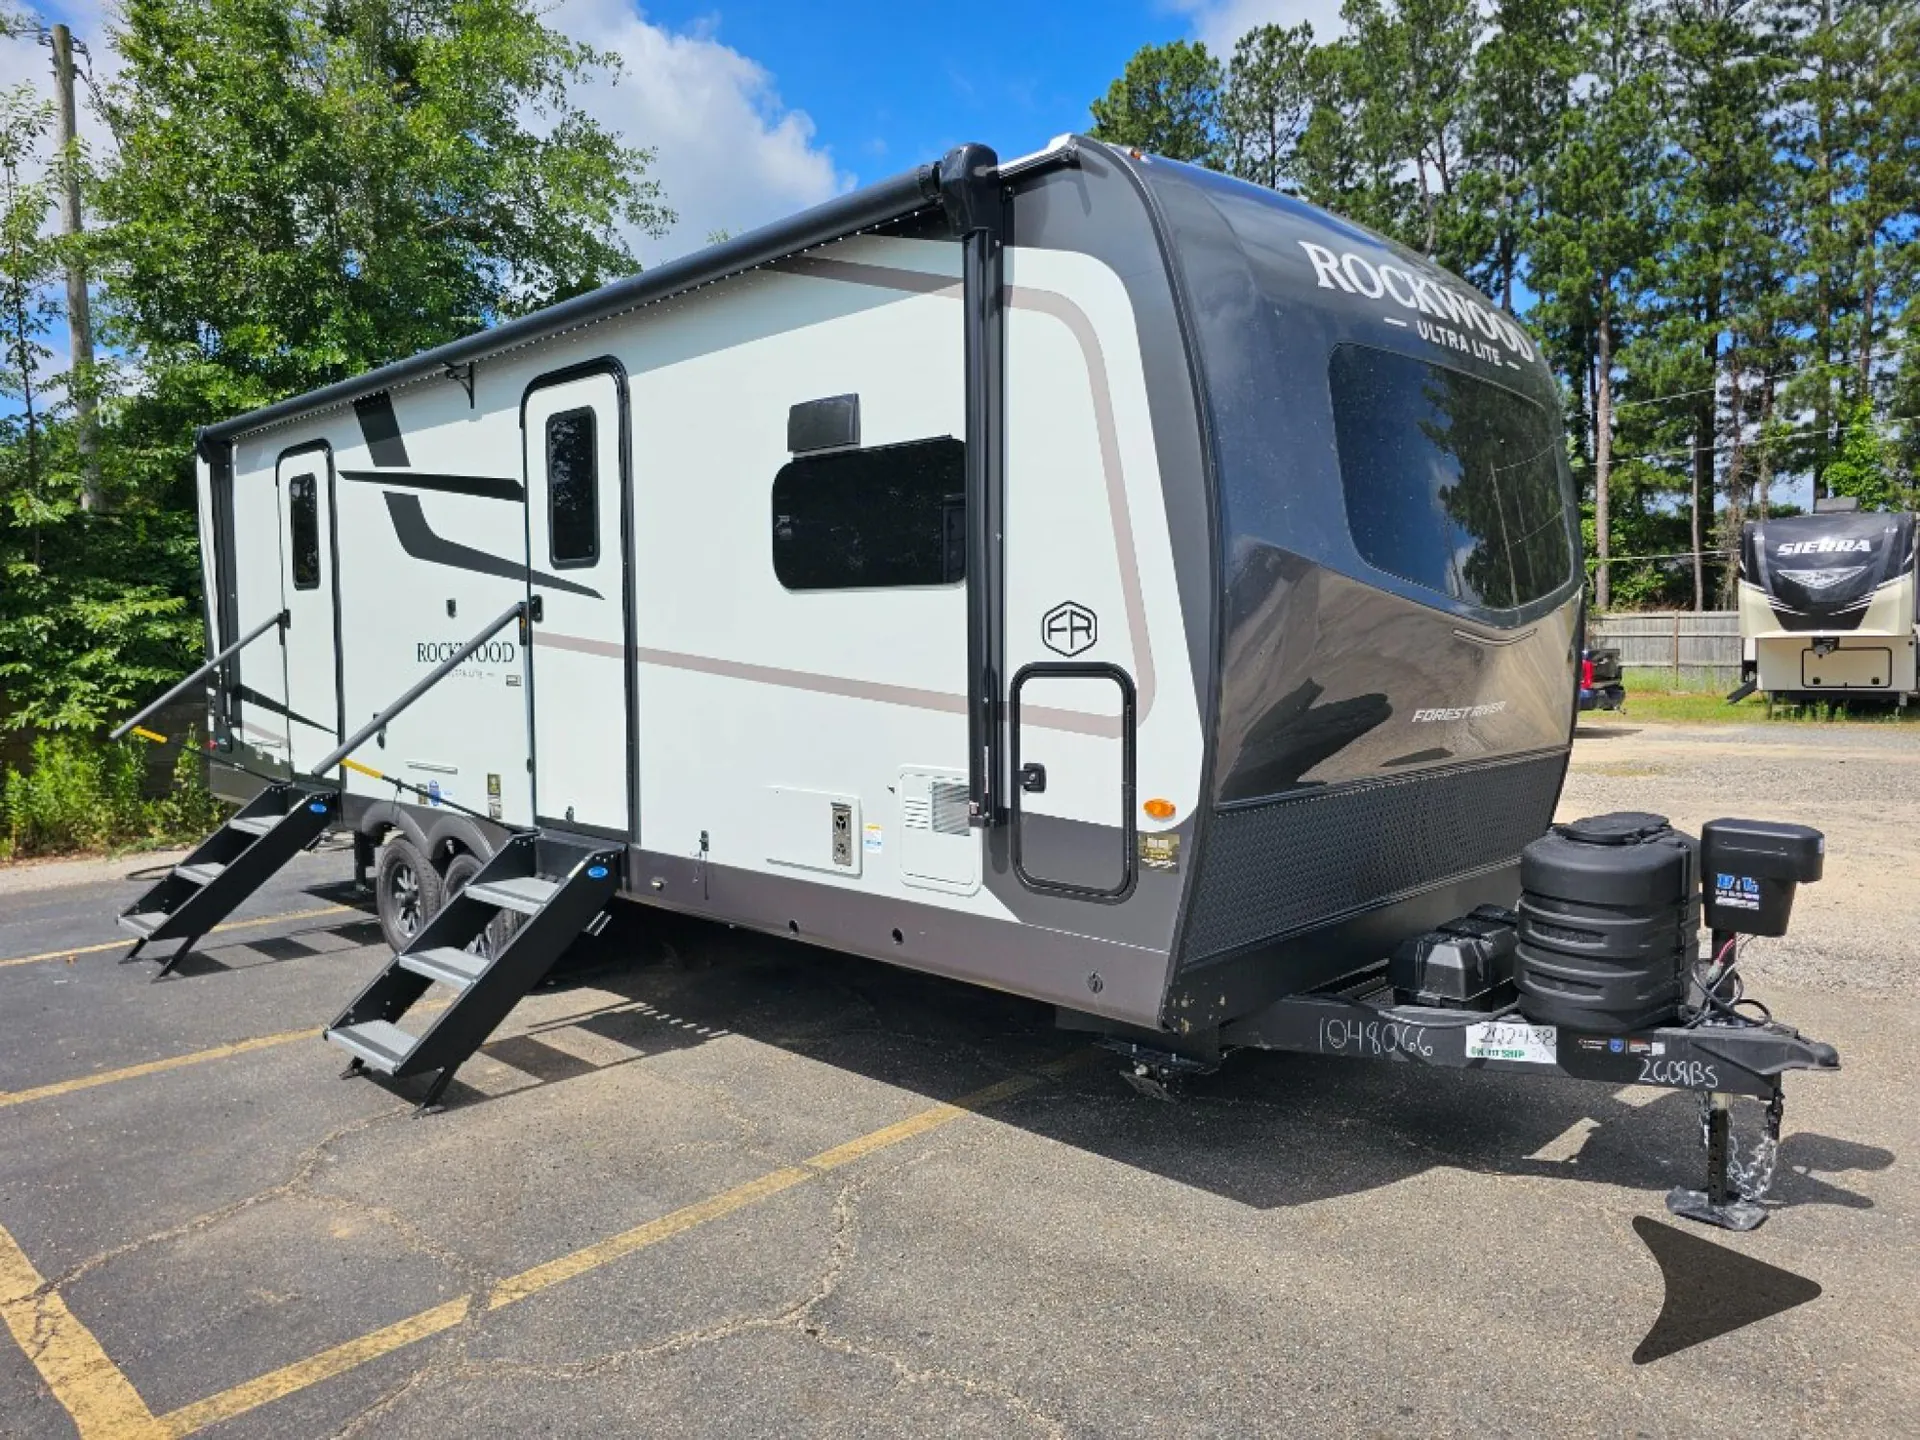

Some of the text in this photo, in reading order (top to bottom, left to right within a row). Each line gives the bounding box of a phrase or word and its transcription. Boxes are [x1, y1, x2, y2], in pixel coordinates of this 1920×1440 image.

[1298, 240, 1535, 363] ROCKWOOD
[1416, 319, 1503, 367] ULTRA LITE
[1776, 537, 1872, 557] SIERRA
[416, 642, 515, 663] ROCKOOD
[1411, 707, 1472, 723] FOREST
